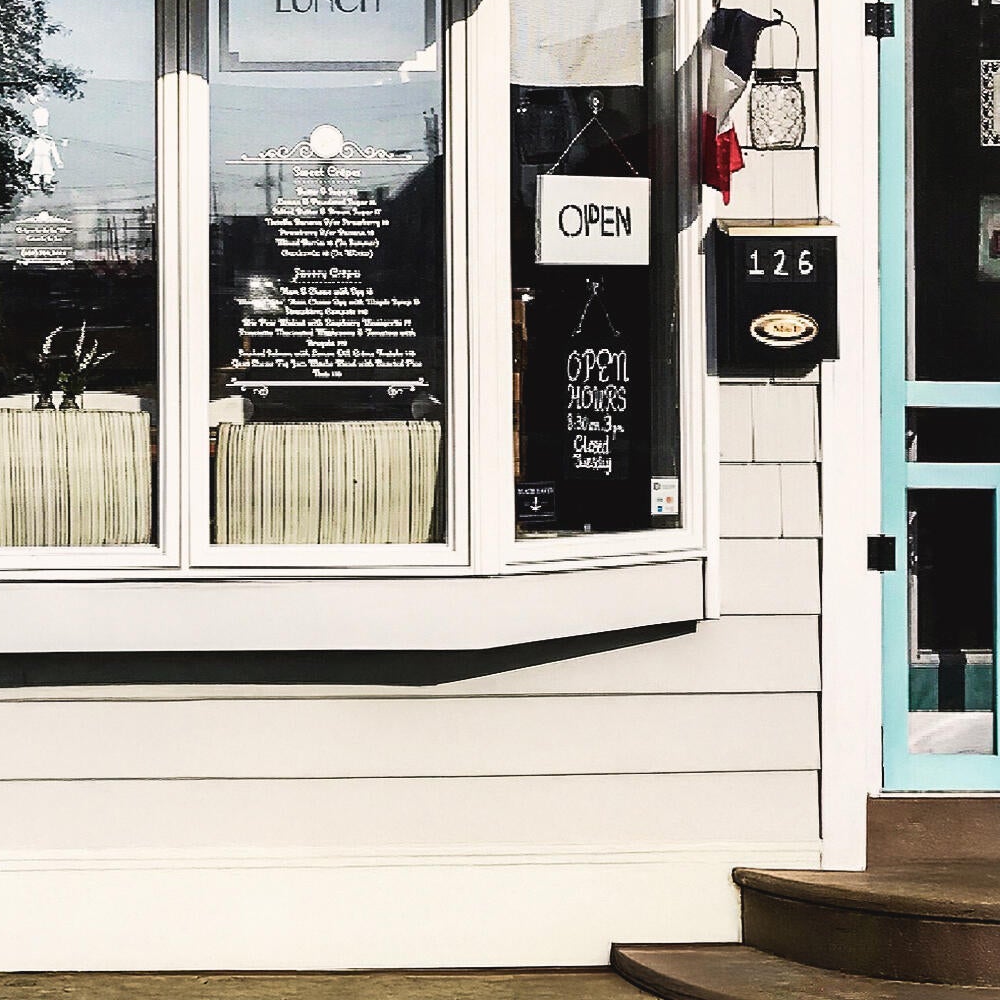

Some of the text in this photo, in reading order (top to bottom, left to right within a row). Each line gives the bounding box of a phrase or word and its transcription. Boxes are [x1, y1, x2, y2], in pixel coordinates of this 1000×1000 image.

[559, 204, 632, 236] OPEN
[749, 249, 814, 275] 126
[567, 349, 629, 382] OPEN
[567, 384, 627, 411] HOURS
